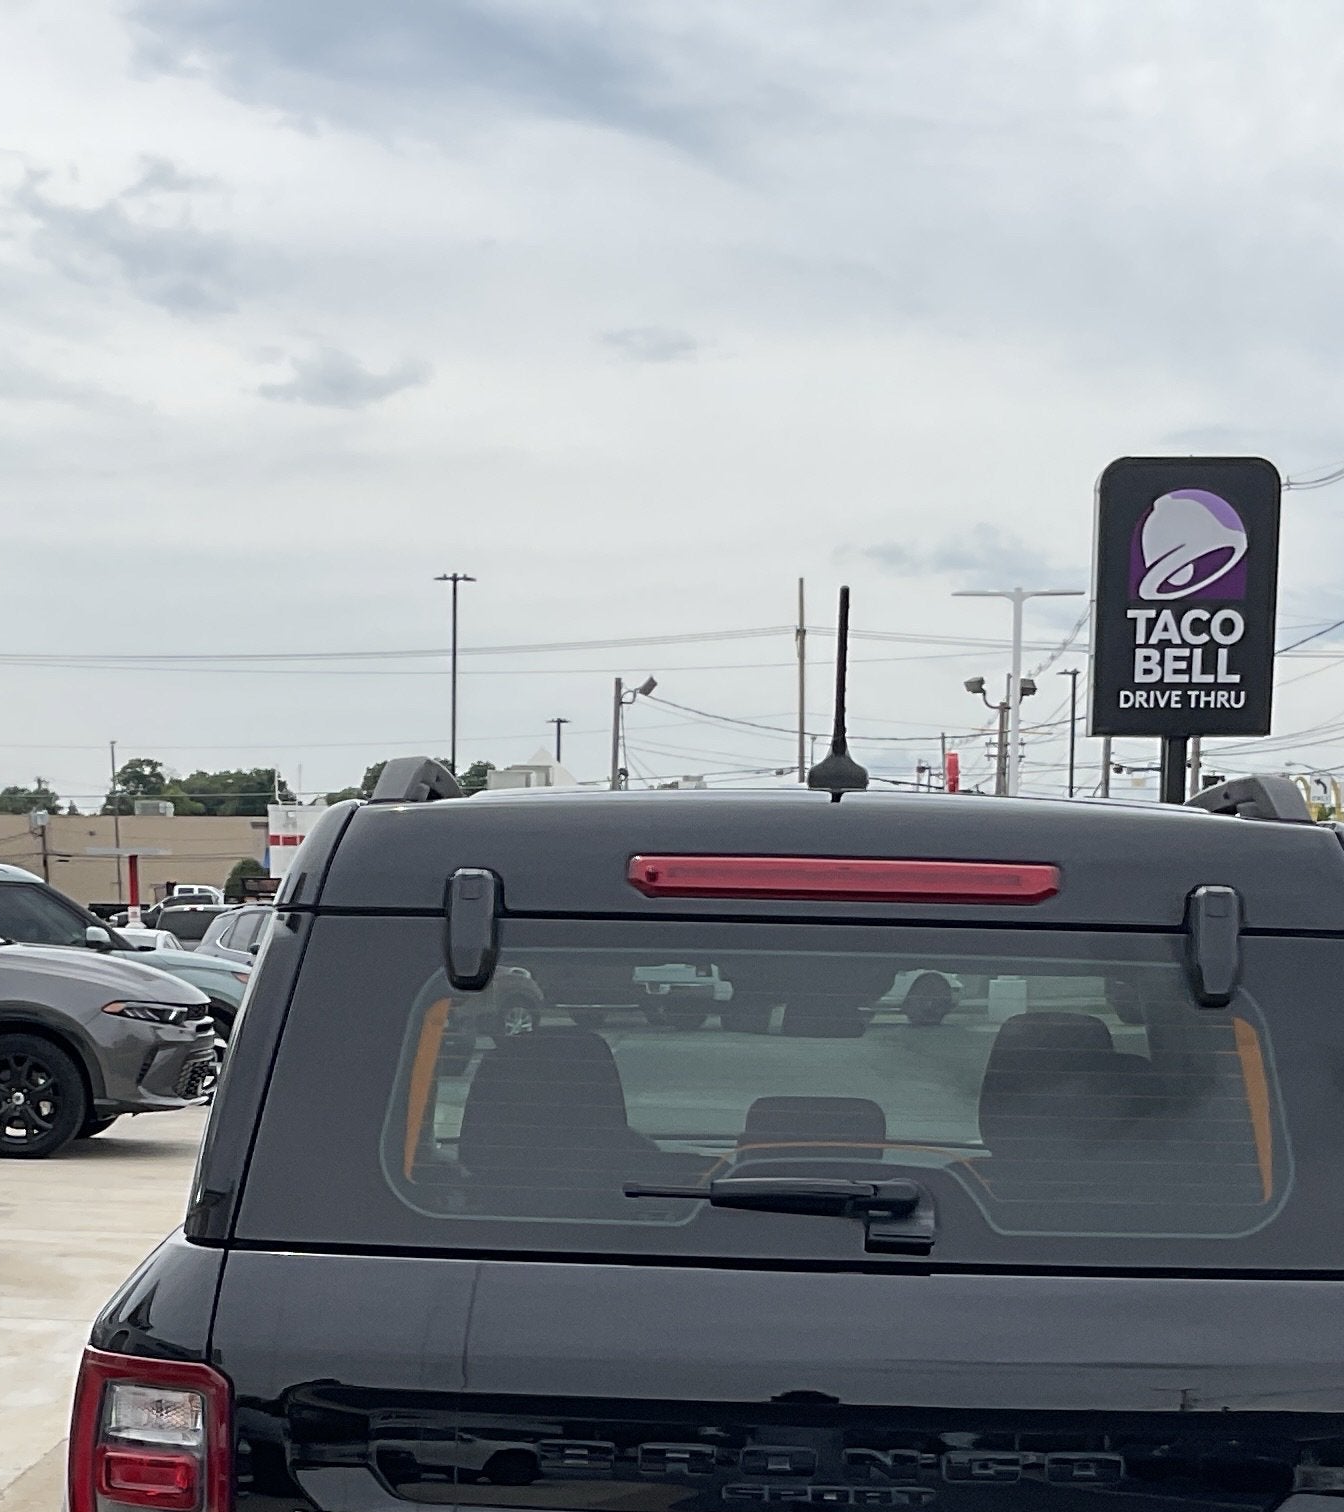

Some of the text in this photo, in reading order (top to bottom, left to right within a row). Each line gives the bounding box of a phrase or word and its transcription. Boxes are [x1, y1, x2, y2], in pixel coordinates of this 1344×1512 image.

[1126, 608, 1245, 645] TACO
[1134, 647, 1241, 684] BELL
[1119, 690, 1246, 709] DRIVE THRU
[536, 1439, 1125, 1484] BRONCO
